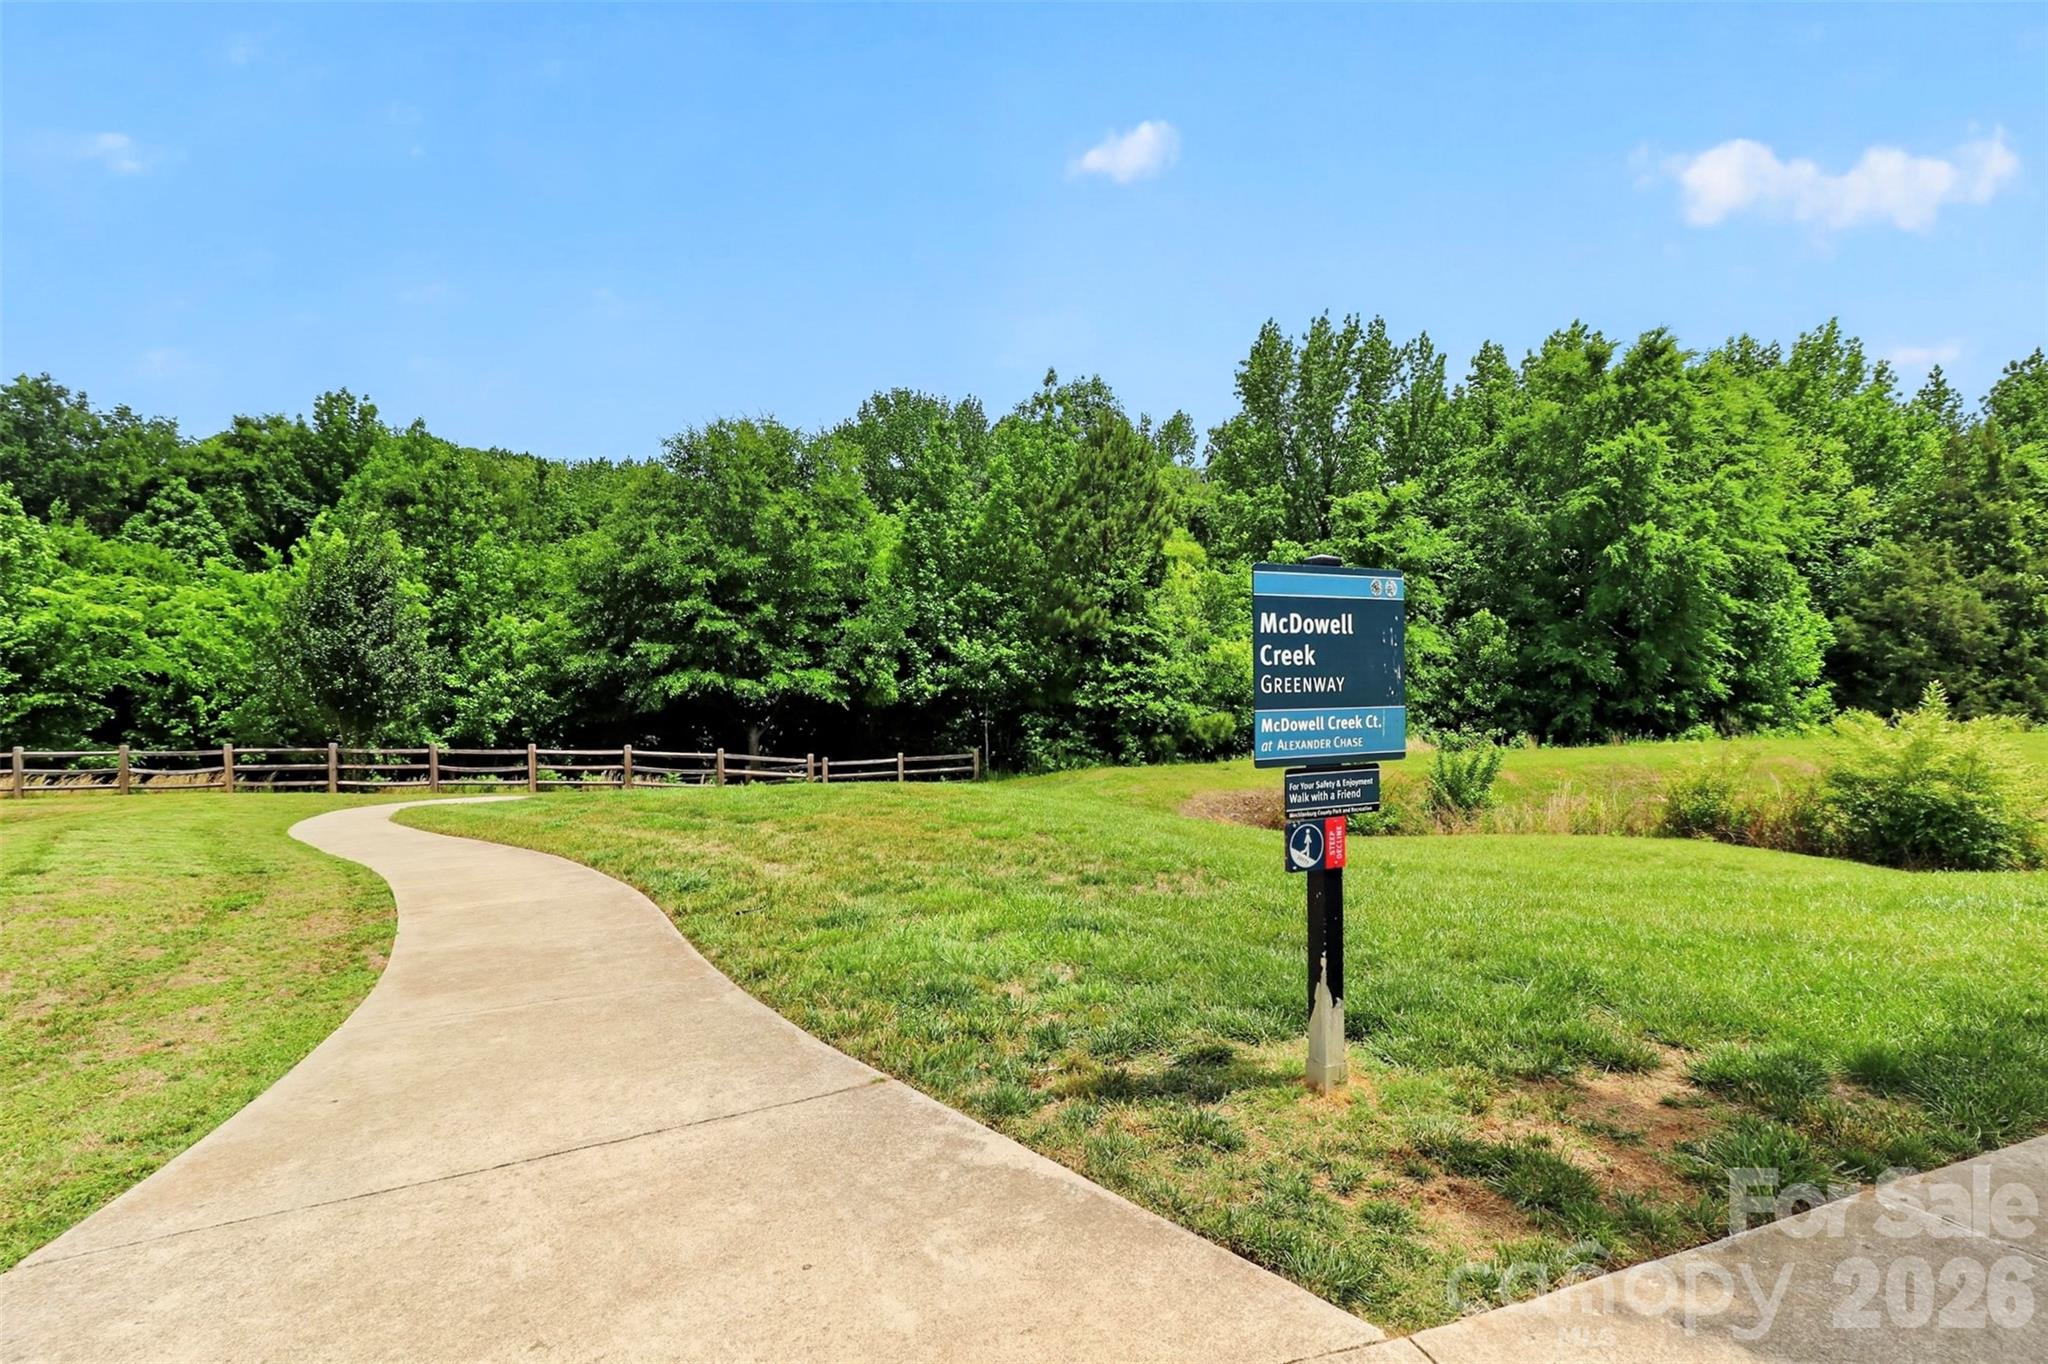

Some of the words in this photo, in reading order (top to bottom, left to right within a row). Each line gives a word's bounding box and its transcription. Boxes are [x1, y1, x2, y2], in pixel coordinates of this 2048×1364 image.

[1260, 612, 1353, 634] McDowell
[1260, 644, 1316, 666] Creek
[1261, 675, 1345, 693] GREENWAY
[1261, 717, 1324, 732] McDowell
[1328, 715, 1362, 729] Creek
[1366, 715, 1382, 728] Ct.
[1261, 741, 1272, 752] at
[1277, 738, 1331, 750] ALEXANDER
[1334, 736, 1363, 747] CHASE
[1300, 782, 1314, 790] Your
[1316, 781, 1335, 789] Safety
[1343, 778, 1373, 786] Enjoyment
[1289, 792, 1309, 803] Walk
[1311, 792, 1328, 801] with
[1337, 789, 1361, 799] Friend
